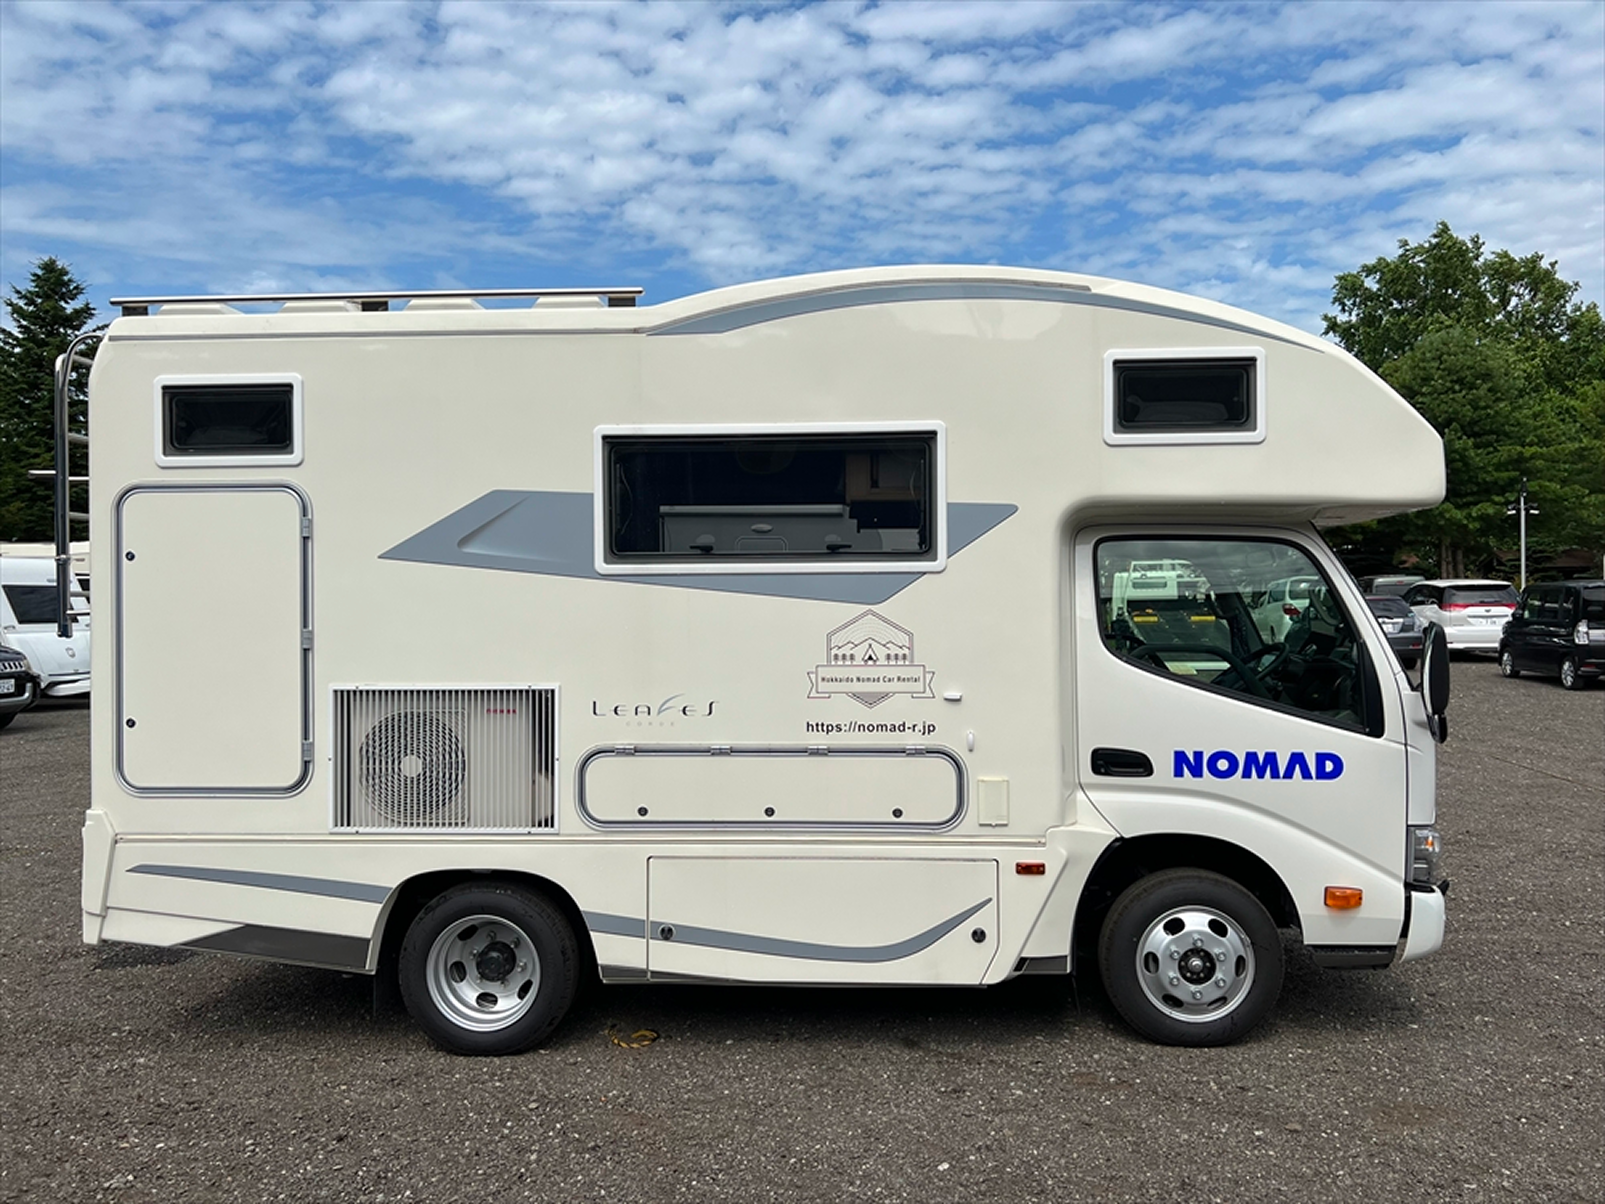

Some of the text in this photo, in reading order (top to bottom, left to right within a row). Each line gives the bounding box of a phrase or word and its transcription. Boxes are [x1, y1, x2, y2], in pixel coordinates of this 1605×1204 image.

[820, 675, 921, 684] Hokkaido Nomad Car Rental
[806, 721, 937, 736] https://nomad-r.jp
[1173, 750, 1344, 780] NOMAD
